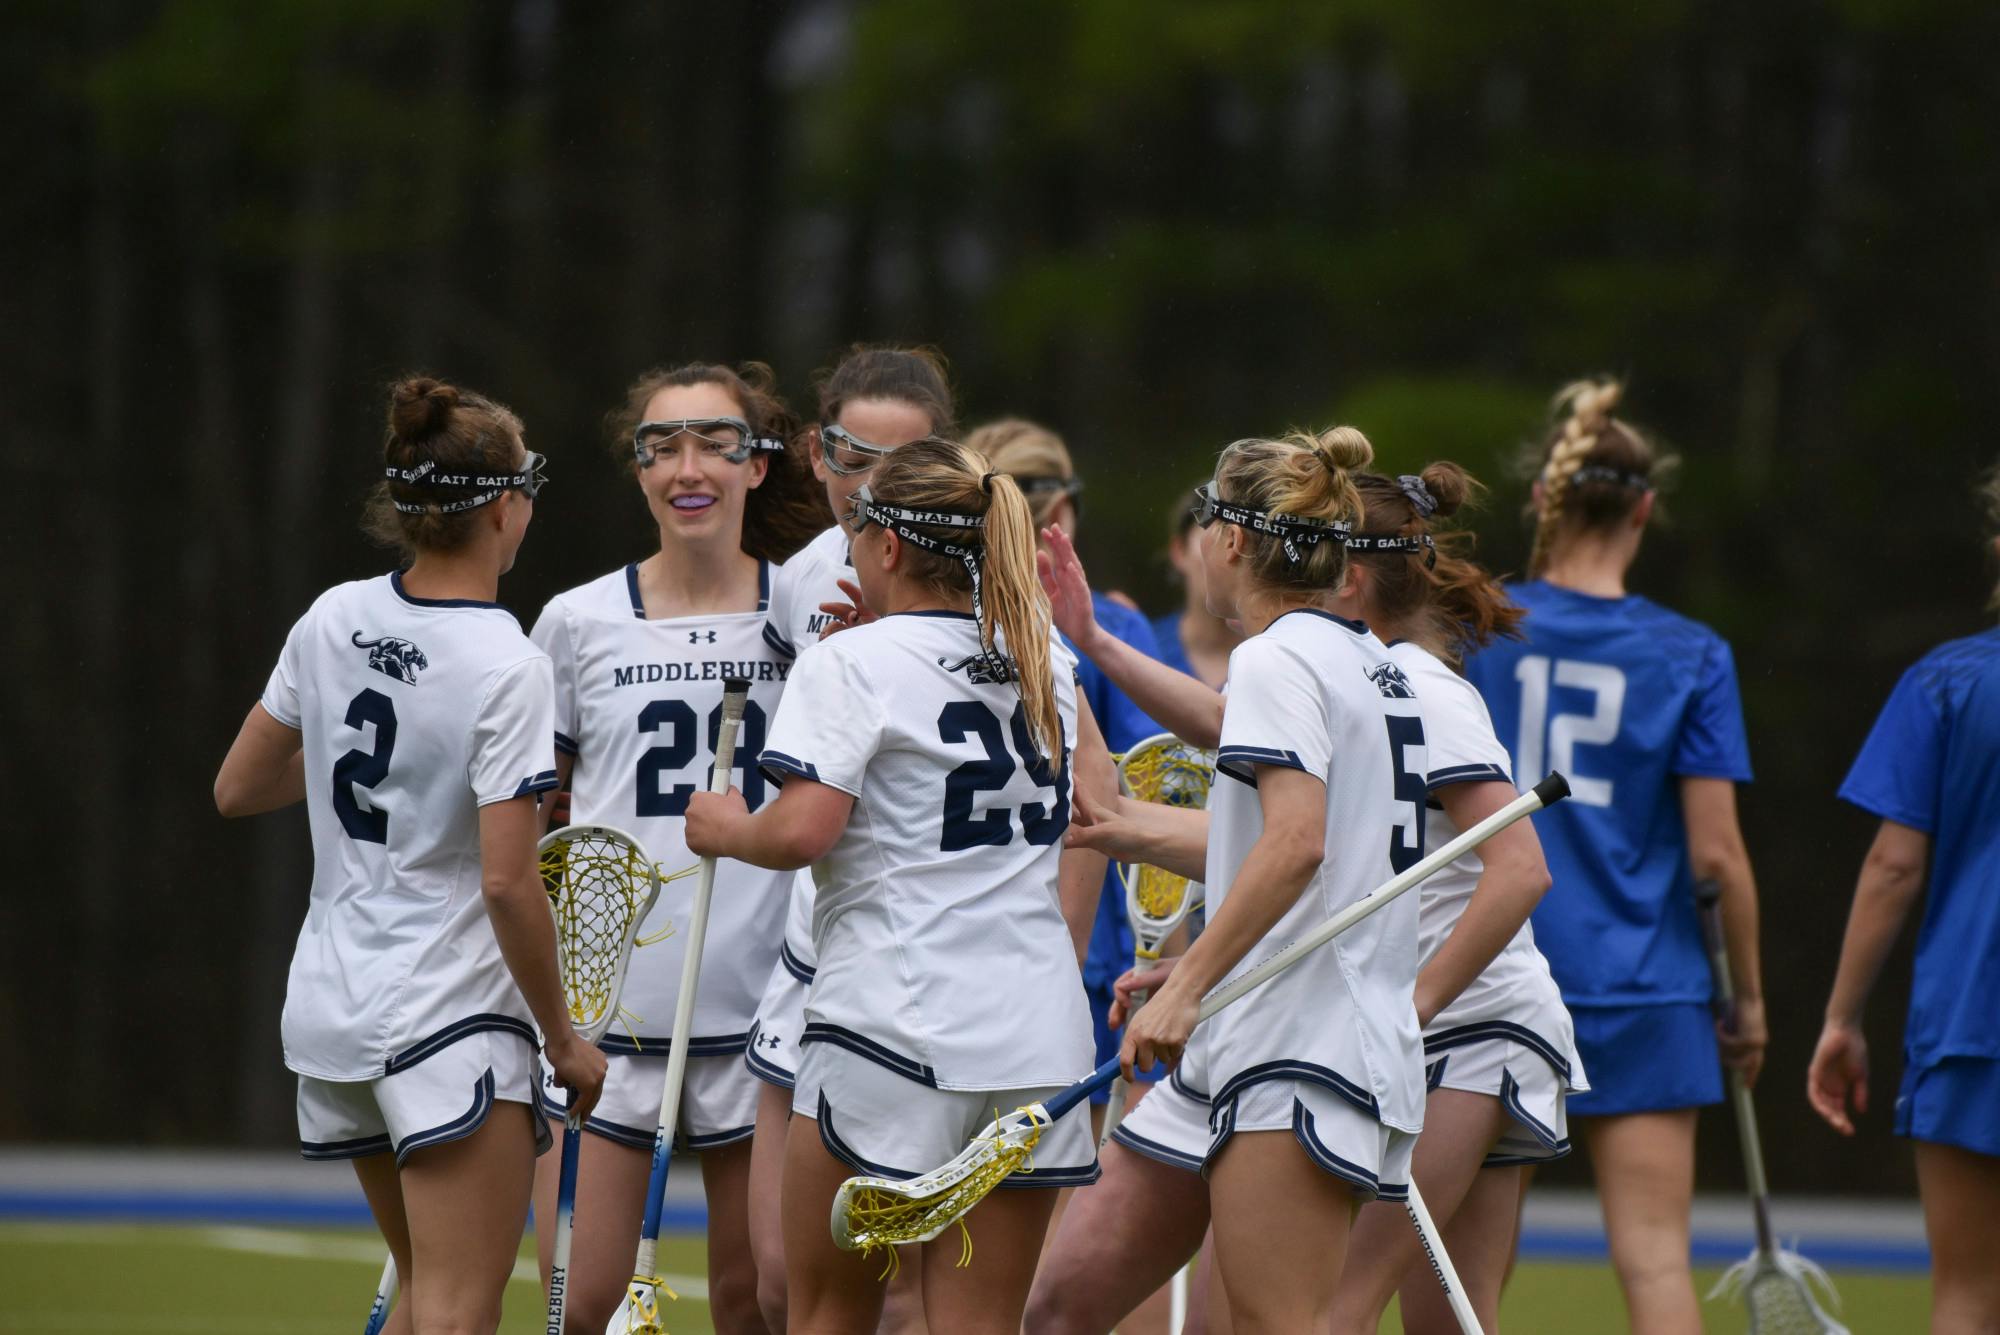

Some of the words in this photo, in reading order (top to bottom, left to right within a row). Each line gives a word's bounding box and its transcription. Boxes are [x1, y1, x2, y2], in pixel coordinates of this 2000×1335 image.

[476, 476, 509, 486] GAIT
[513, 475, 526, 485] GA
[866, 506, 894, 528] GAIT
[899, 526, 938, 549] GAIT
[944, 545, 966, 557] GA
[1222, 508, 1249, 525] GAIT
[1253, 519, 1289, 536] GAIT
[1344, 538, 1371, 548] AIT
[1377, 537, 1409, 548] GAIT
[614, 661, 790, 688] MIDDLEBURY
[1514, 655, 1627, 808] 12
[332, 687, 398, 846] 2
[936, 699, 1072, 852] 29
[1384, 713, 1427, 875] 5
[547, 1265, 566, 1335] DLEBURY
